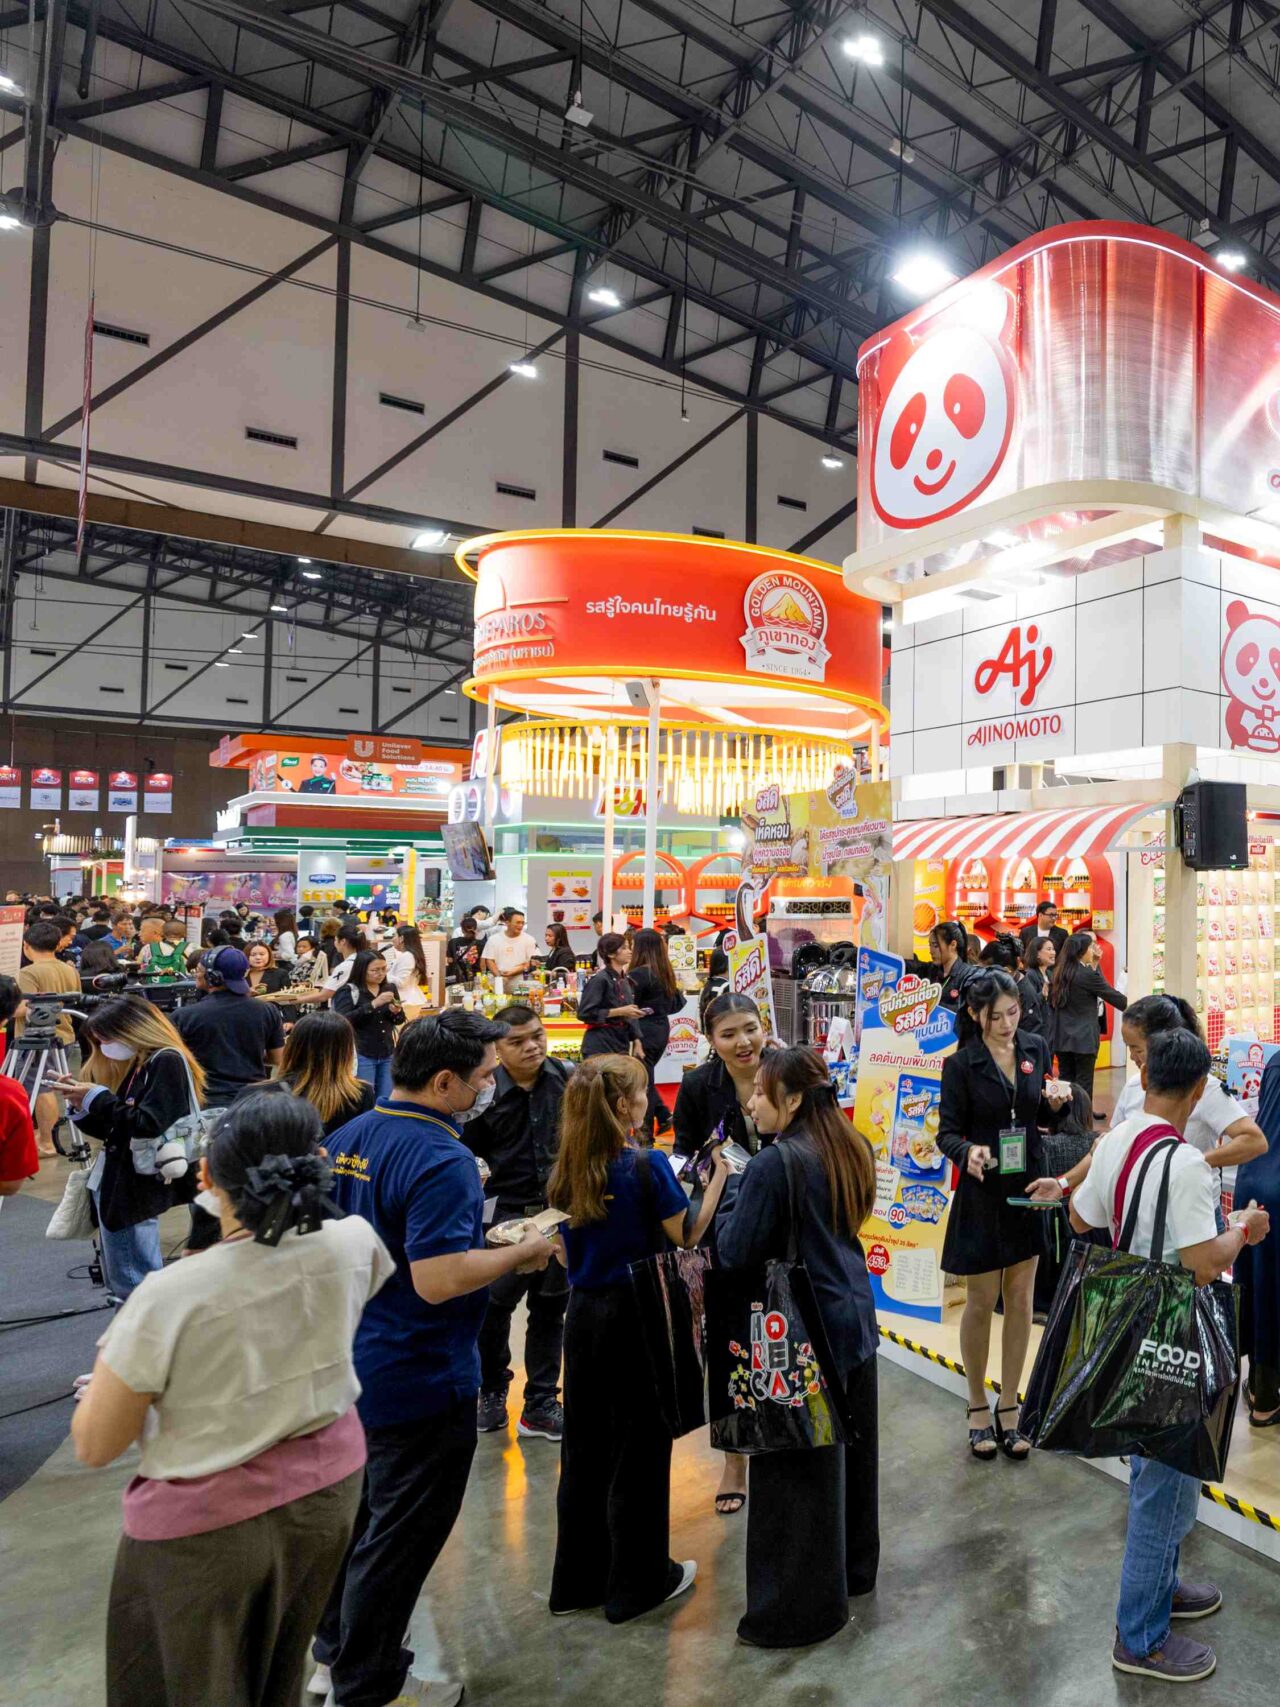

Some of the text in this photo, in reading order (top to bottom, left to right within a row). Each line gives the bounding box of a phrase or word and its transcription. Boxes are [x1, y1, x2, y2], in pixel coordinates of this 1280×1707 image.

[586, 595, 717, 624] รสรู้ใจคนไทยรู้กัน
[751, 575, 823, 630] GOLDEN MOUNTAIN
[758, 630, 817, 651] ภูเขาทอง
[765, 663, 789, 674] SINCE
[974, 624, 1053, 707] Aj
[967, 714, 1061, 747] AJINOMOTO
[382, 742, 411, 750] Unilever
[756, 784, 780, 812] รสดี
[755, 817, 790, 841] เห็ดหอม
[881, 979, 939, 1018] ซุปก๋วยเตี๋ยว
[894, 1003, 928, 1034] รสดี
[915, 1014, 949, 1039] แบบน้ำ
[1138, 1338, 1201, 1370] FOOD
[1136, 1357, 1199, 1380] INFINITY
